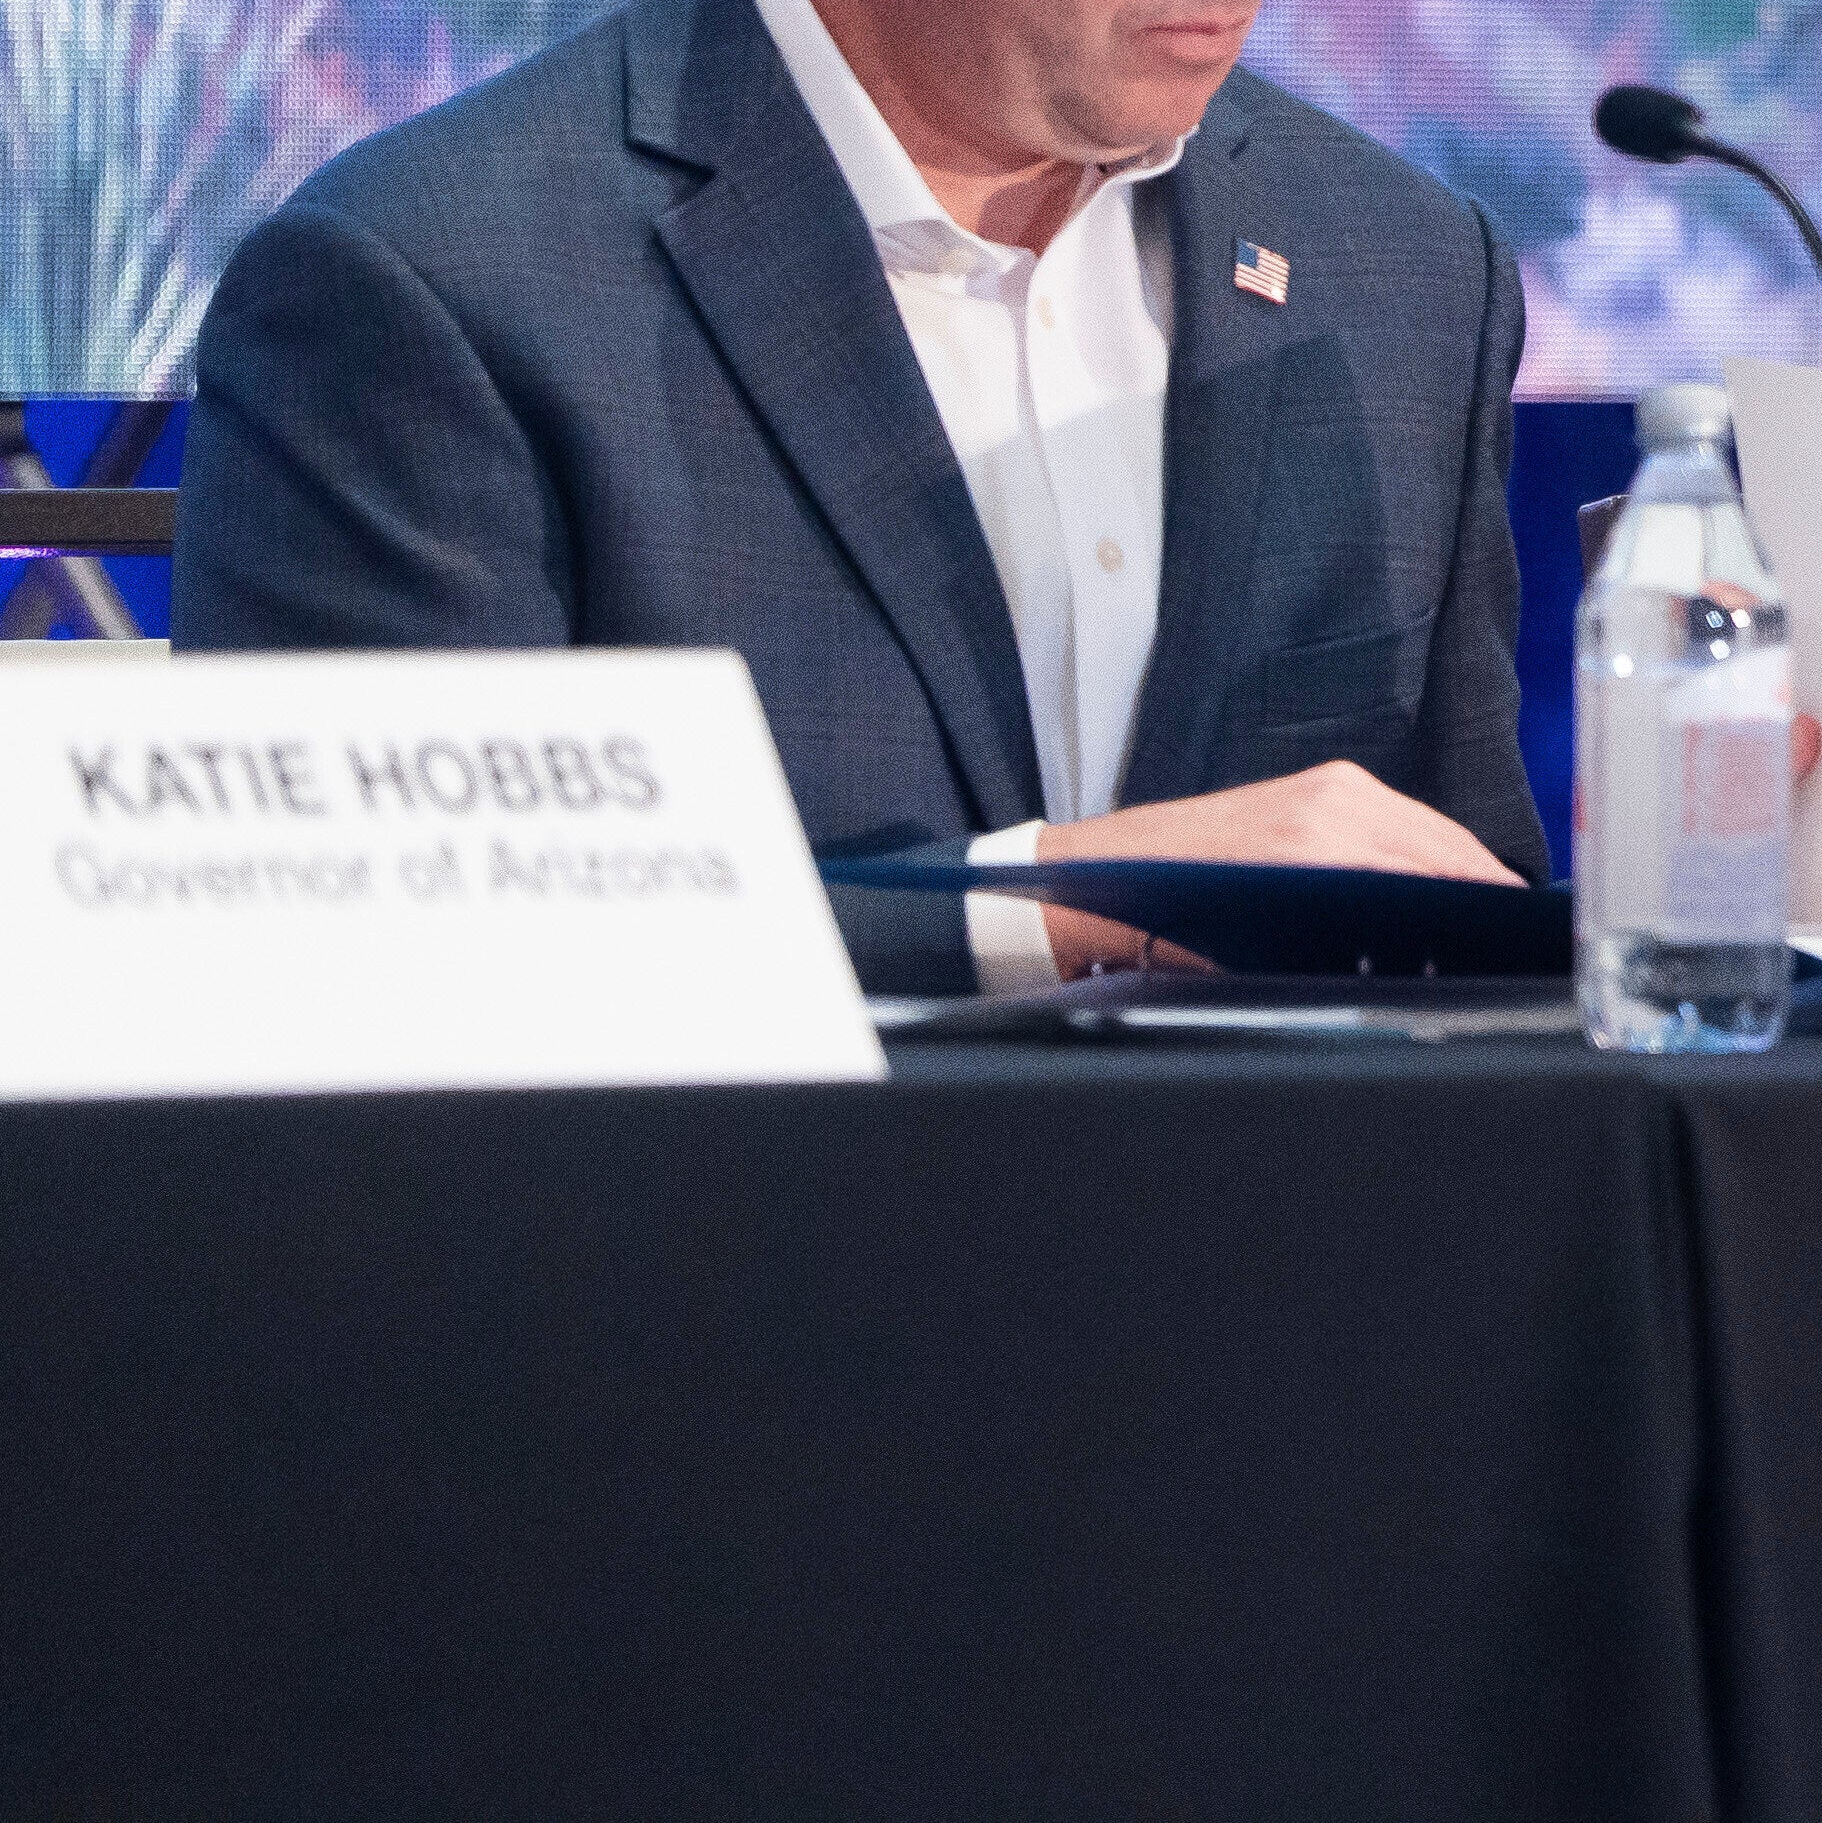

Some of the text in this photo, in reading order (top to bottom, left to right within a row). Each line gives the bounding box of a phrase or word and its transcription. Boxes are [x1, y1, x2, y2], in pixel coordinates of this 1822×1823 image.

[64, 733, 667, 820] KATIE HOBBS
[52, 835, 742, 909] Governor of Arizona
